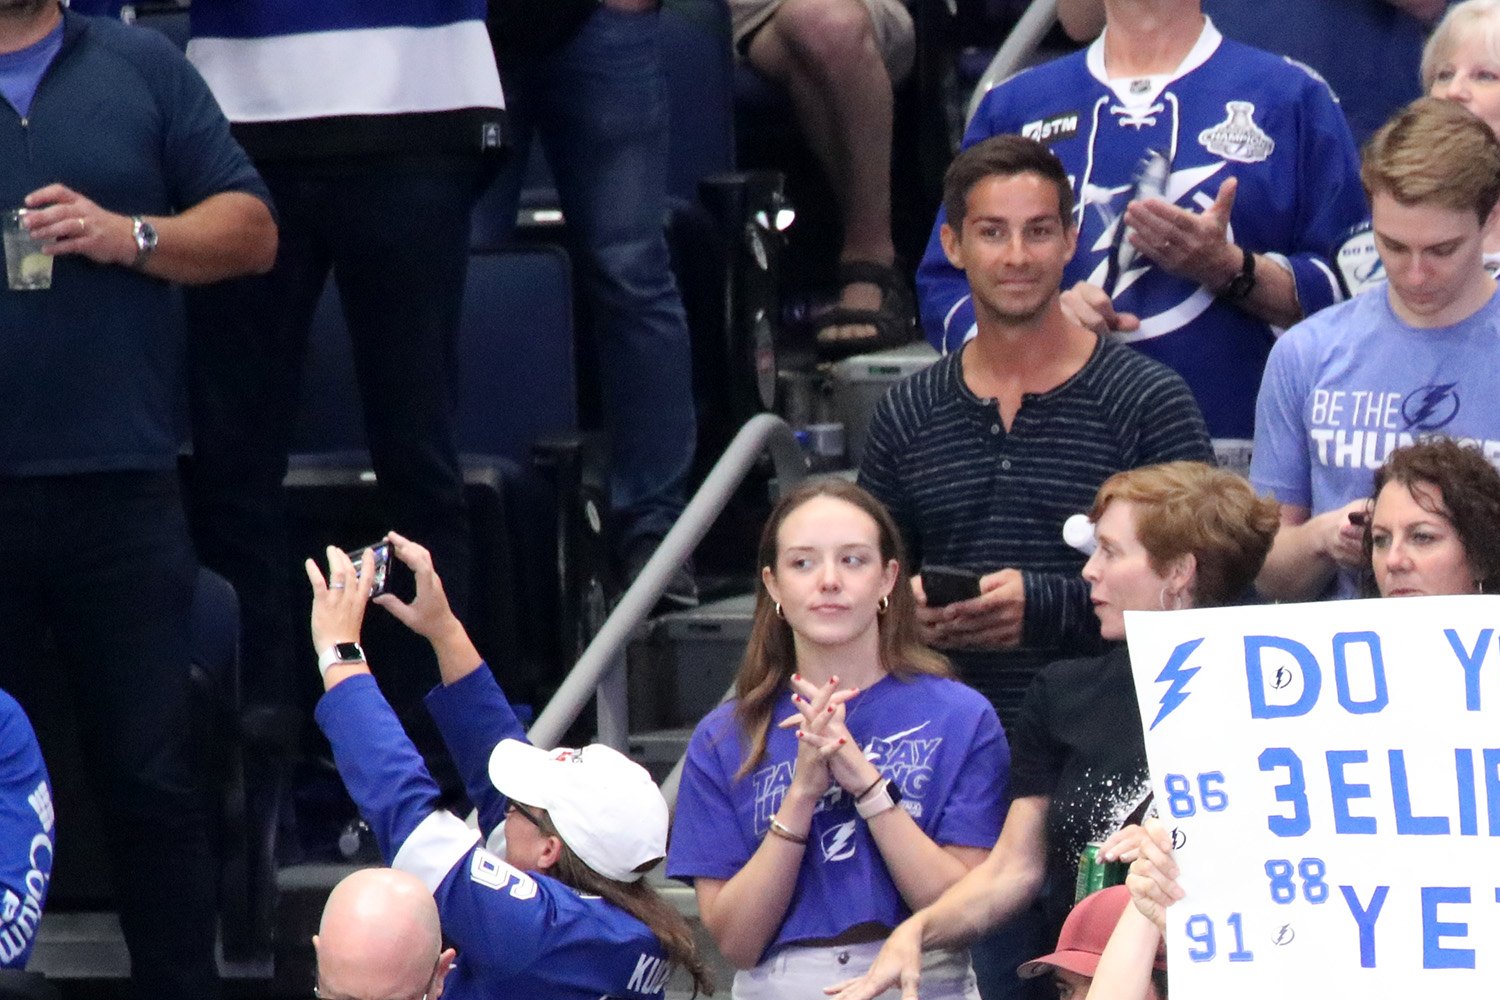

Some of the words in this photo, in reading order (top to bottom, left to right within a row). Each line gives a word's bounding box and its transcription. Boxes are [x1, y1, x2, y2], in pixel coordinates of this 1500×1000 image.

[1311, 389, 1346, 426] BE
[1350, 391, 1402, 429] THE
[1243, 631, 1389, 719] DO
[871, 736, 943, 768] BAY
[1164, 770, 1229, 819] 86
[1264, 857, 1329, 905] 88
[1185, 911, 1254, 963] 91
